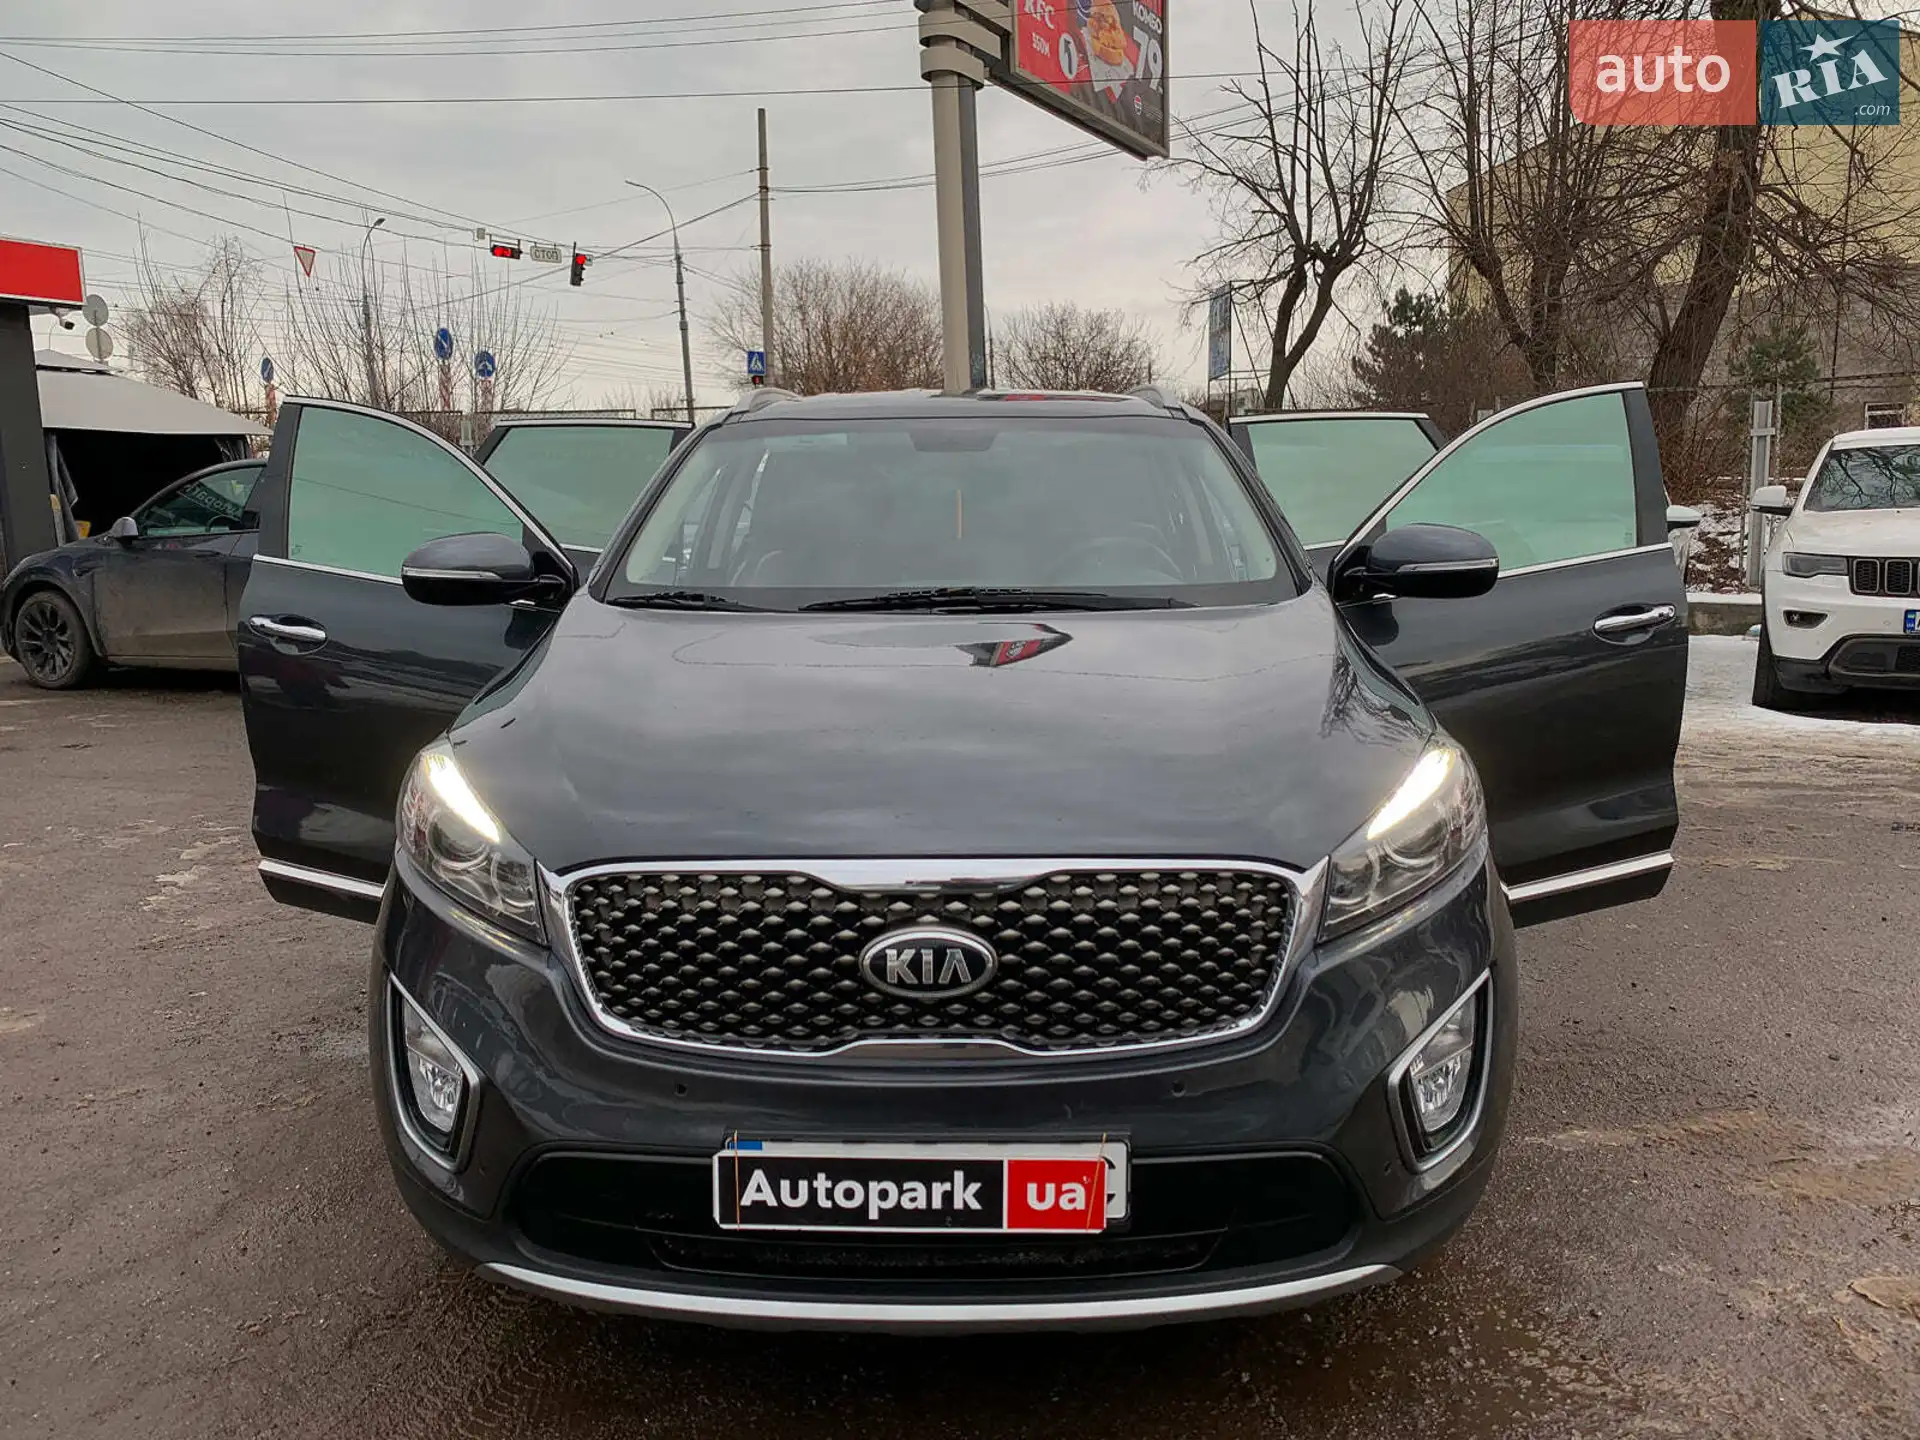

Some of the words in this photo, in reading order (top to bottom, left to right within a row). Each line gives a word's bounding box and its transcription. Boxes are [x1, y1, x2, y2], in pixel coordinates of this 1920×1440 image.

[885, 948, 972, 984] KIA
[739, 1168, 983, 1220] Autopark
[1026, 1181, 1087, 1211] ua
